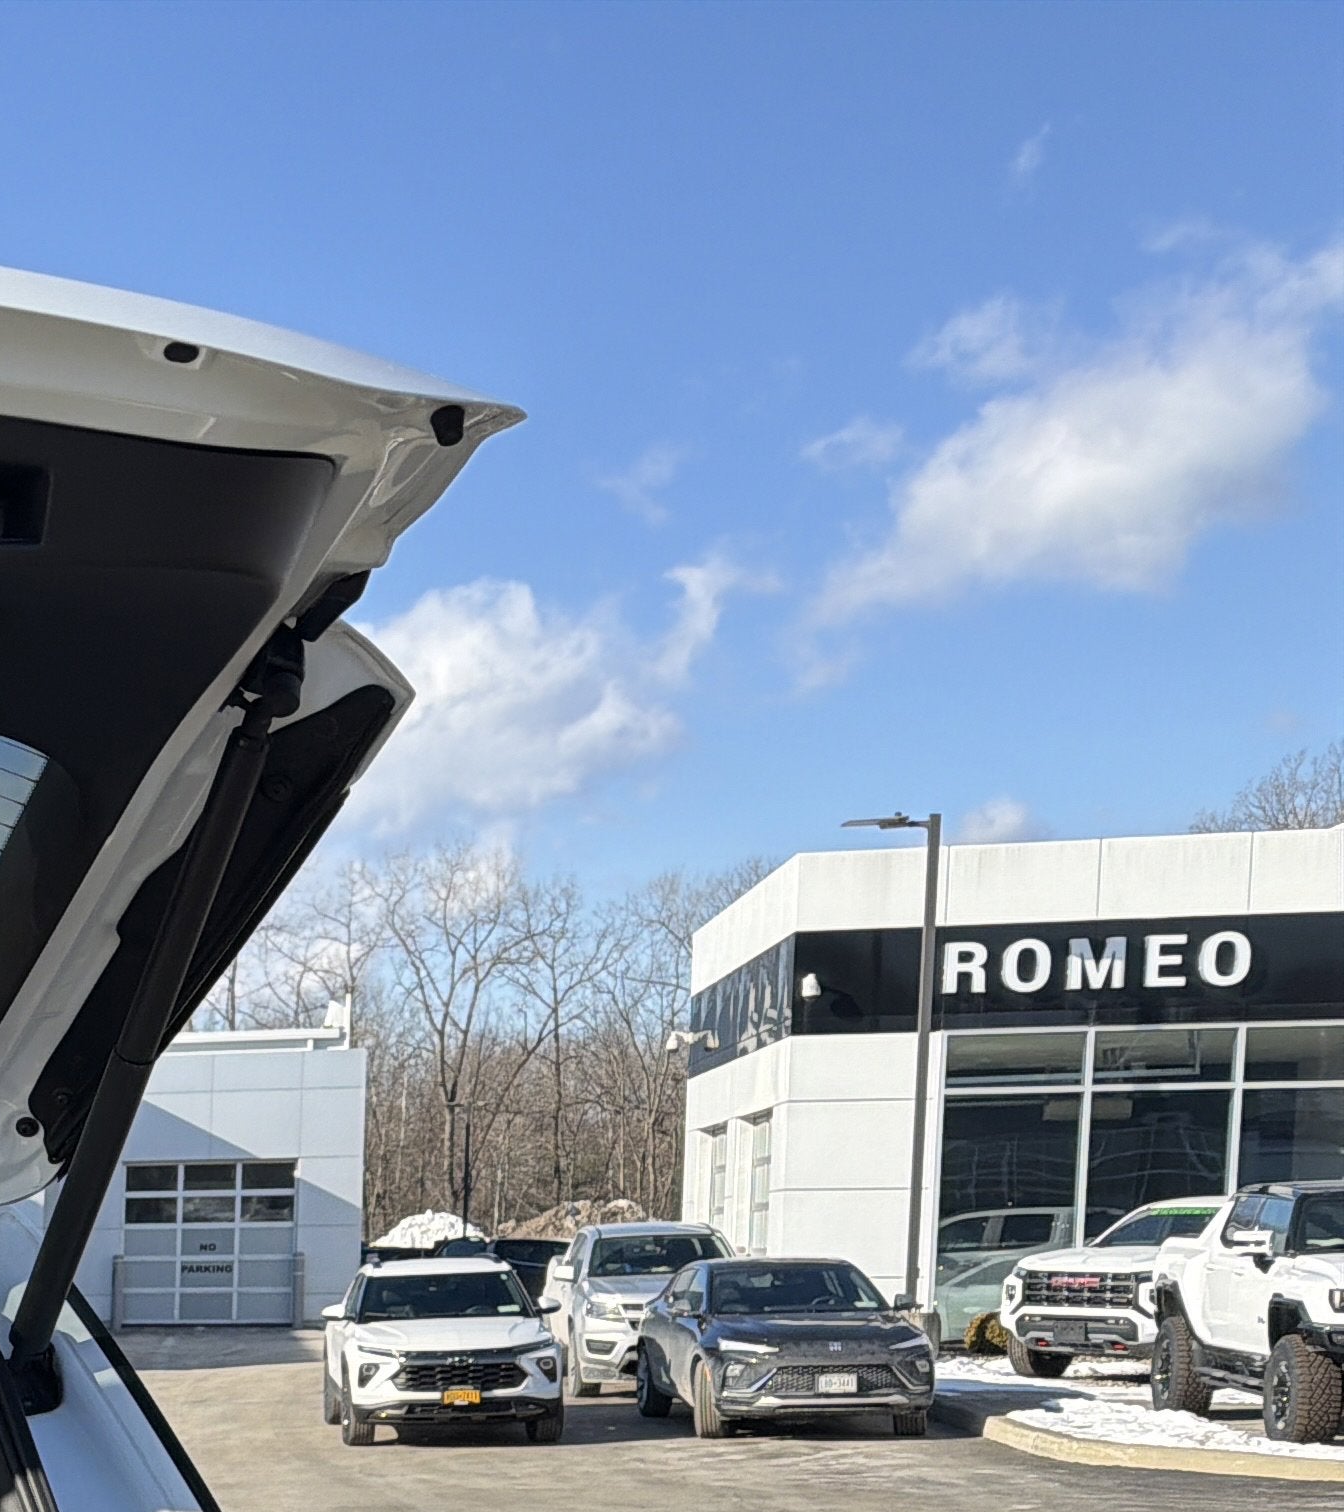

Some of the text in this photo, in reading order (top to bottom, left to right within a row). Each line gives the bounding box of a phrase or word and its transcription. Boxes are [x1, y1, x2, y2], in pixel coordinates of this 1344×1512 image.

[942, 930, 1252, 994] ROMEO
[199, 1243, 217, 1252] NO
[181, 1264, 233, 1273] PARKING
